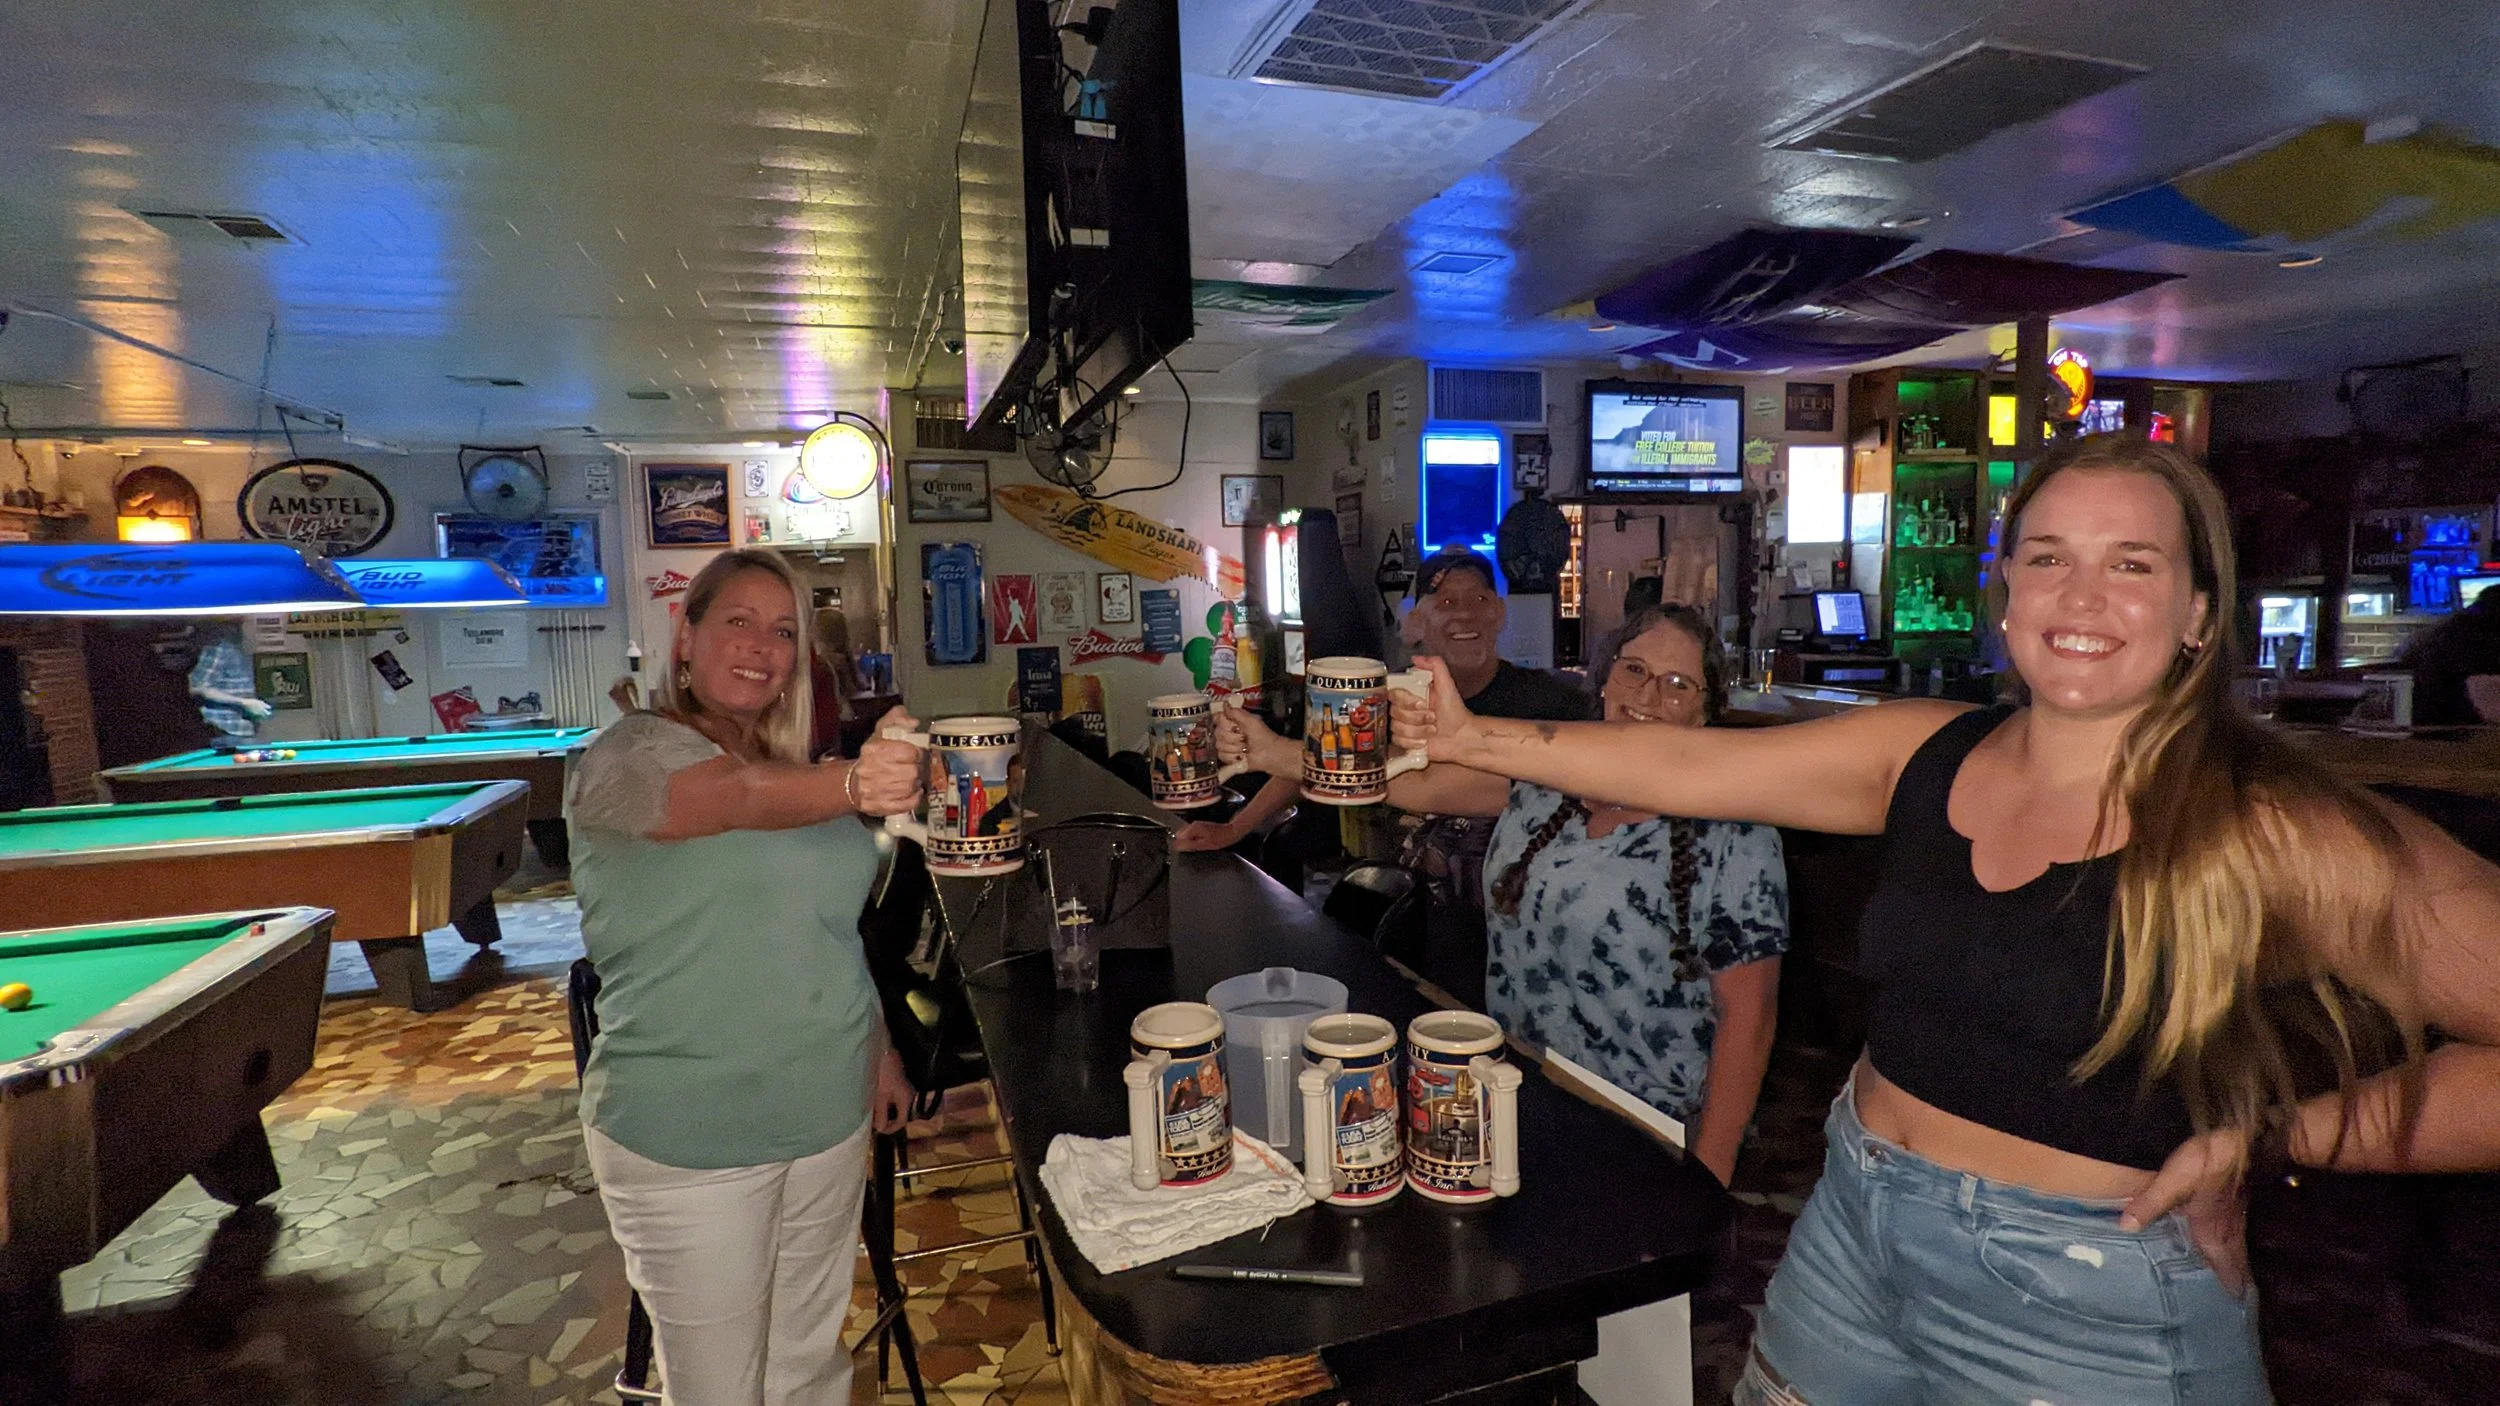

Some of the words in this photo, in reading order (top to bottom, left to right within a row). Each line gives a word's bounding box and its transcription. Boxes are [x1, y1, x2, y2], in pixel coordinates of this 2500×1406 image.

[1641, 431, 1662, 441] VOTED
[1663, 431, 1676, 441] FOR
[1635, 441, 1654, 452] FREE
[1655, 441, 1685, 452] COLLEGE
[1687, 441, 1715, 453] TUITION
[1641, 453, 1669, 465] ILLEGAL
[1671, 453, 1717, 466] IMMIGRANTS
[923, 478, 973, 496] Corona
[268, 496, 365, 515] AMSTEL
[359, 571, 424, 581] BUD
[350, 581, 427, 590] IGHT
[1069, 635, 1145, 657] Budwe
[1317, 677, 1376, 689] QUALITY
[1157, 705, 1205, 717] QUALITY
[1083, 713, 1102, 722] UD
[936, 735, 943, 746] A
[950, 734, 1010, 747] LEGACY
[1210, 1040, 1218, 1052] A
[1383, 1051, 1390, 1064] A
